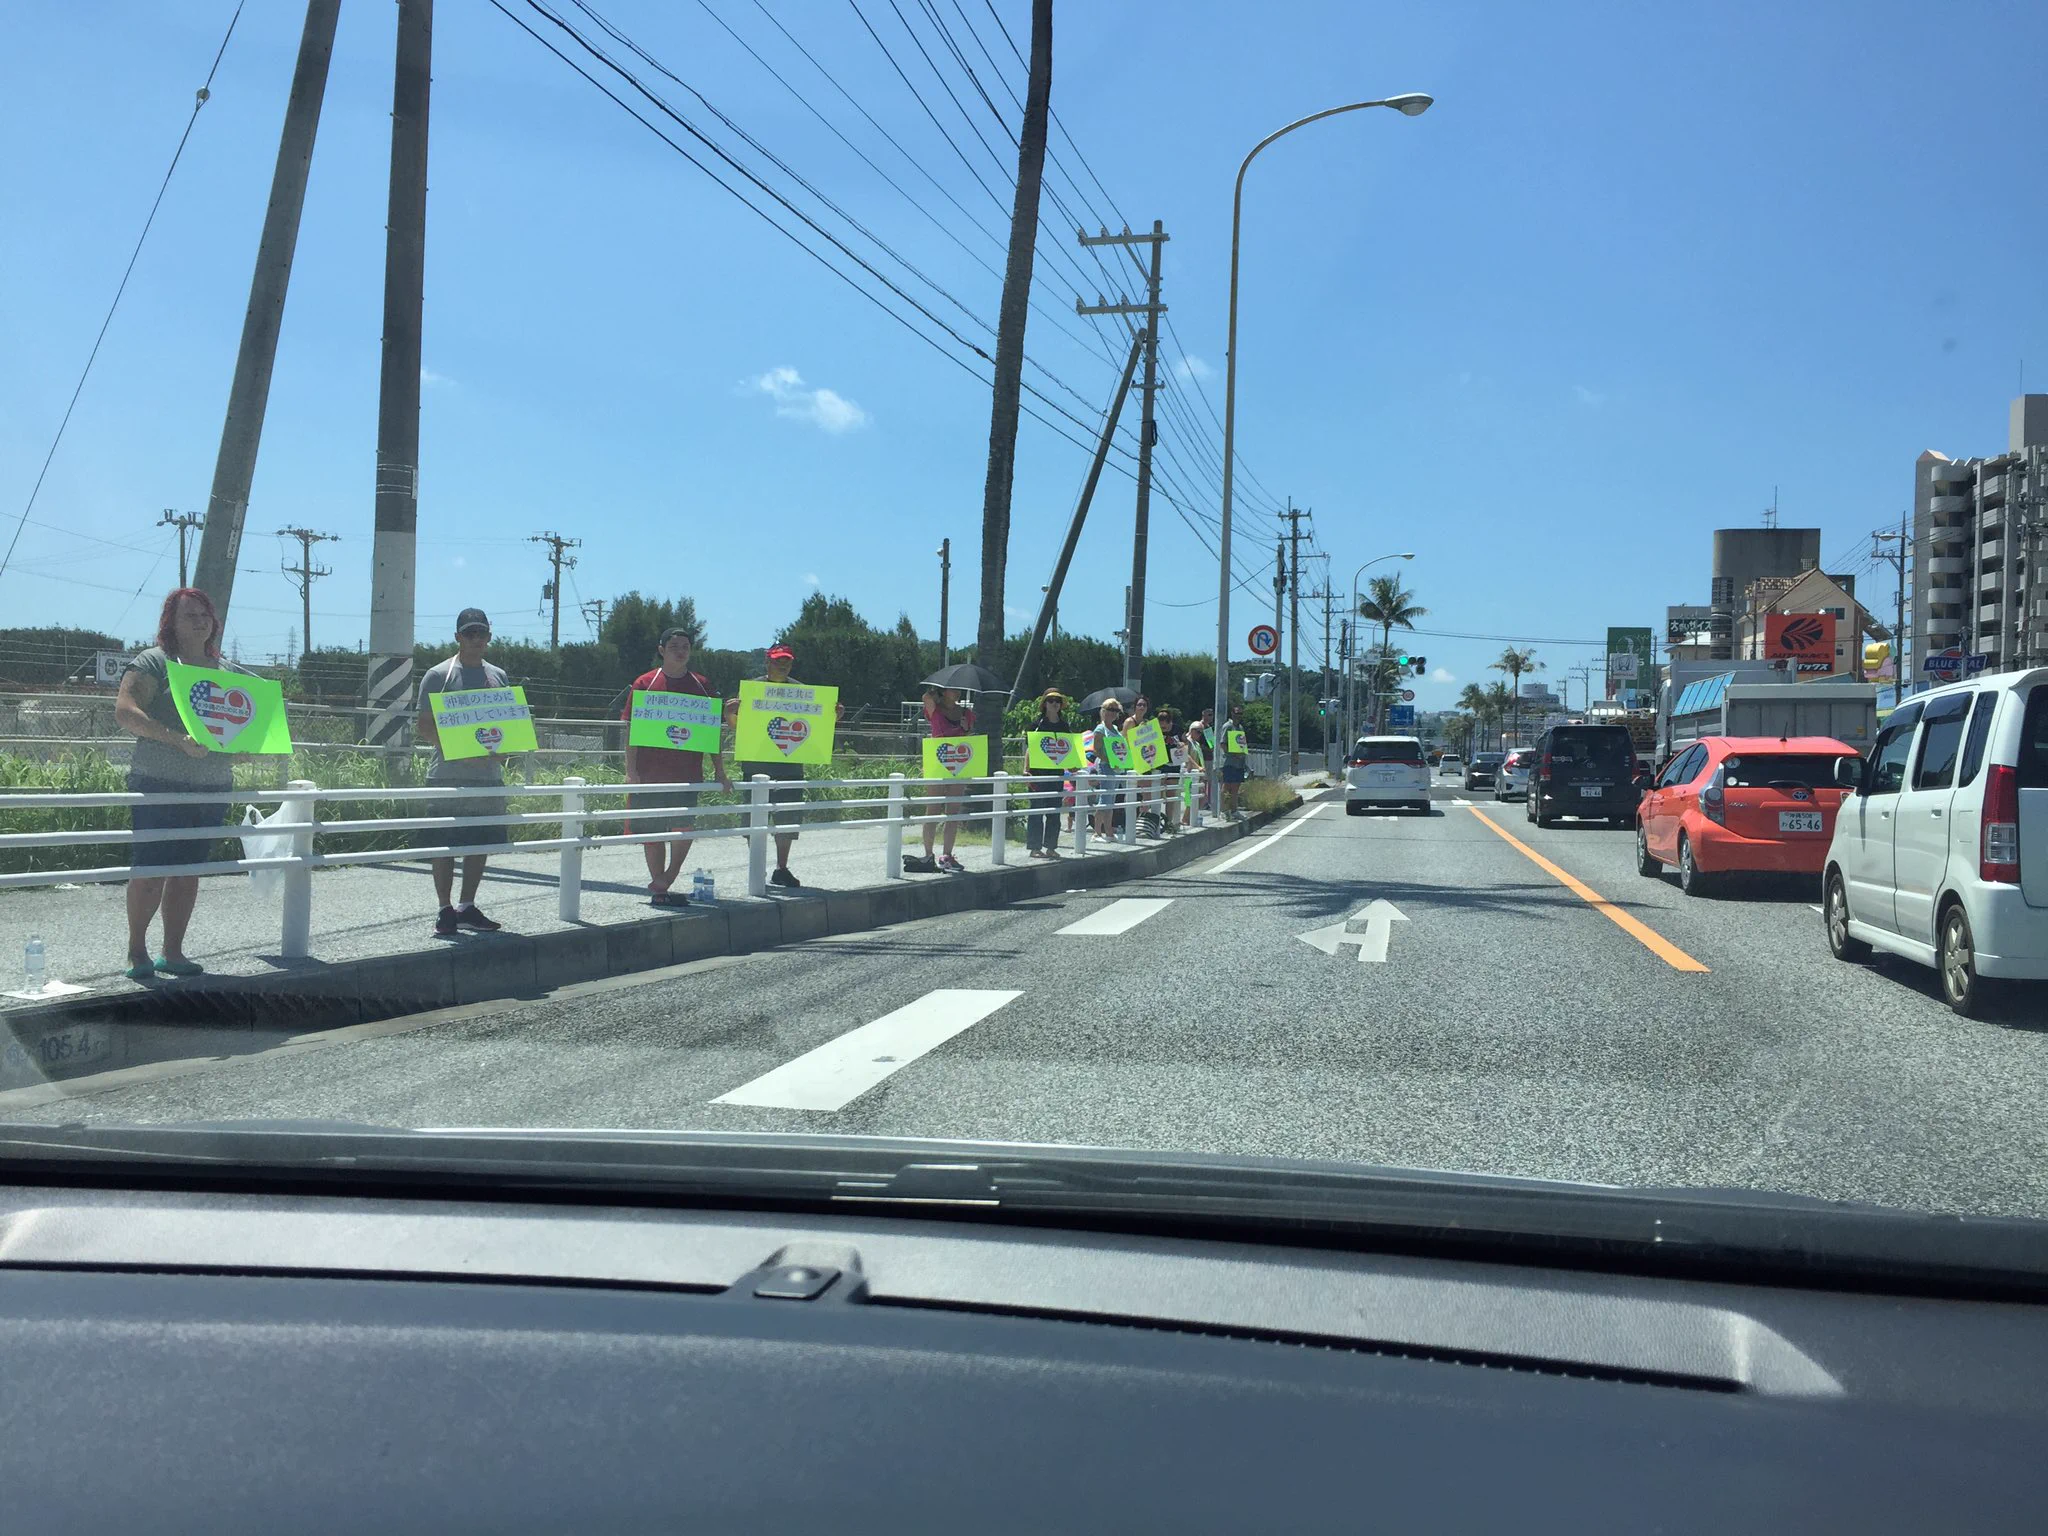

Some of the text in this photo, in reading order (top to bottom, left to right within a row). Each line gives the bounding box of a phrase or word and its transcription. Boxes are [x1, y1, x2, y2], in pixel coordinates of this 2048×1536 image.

[1928, 660, 1981, 668] BLUE SAL
[447, 692, 514, 708] 沖縄のために
[766, 687, 813, 699] 沖縄と共に
[646, 695, 709, 709] 沖縄のために
[440, 706, 528, 725] お祈りしています
[634, 709, 720, 725] お祈りしています
[1789, 820, 1820, 830] 65-46
